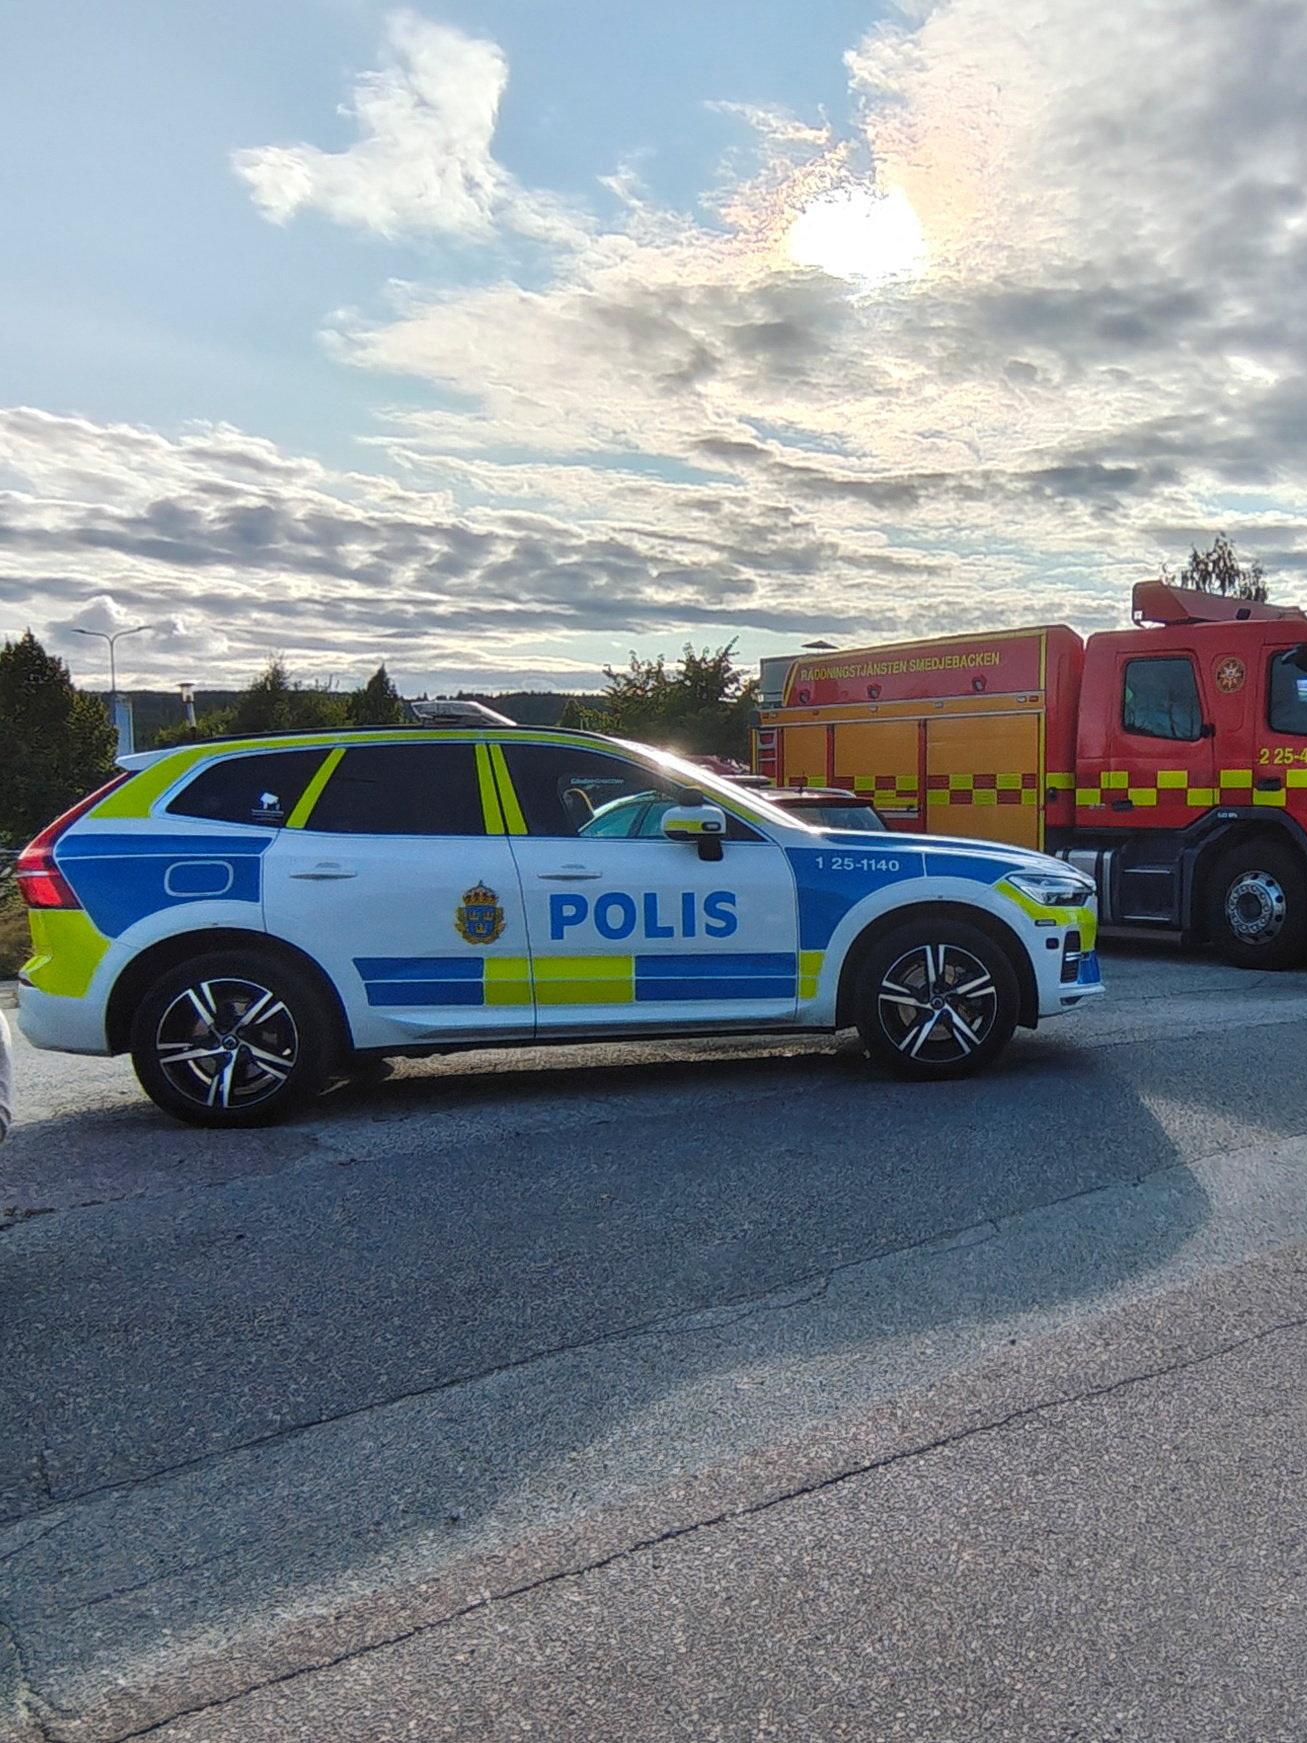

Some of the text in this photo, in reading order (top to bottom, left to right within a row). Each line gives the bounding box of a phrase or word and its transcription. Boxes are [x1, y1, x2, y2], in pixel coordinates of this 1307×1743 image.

[908, 652, 1000, 672] SMEDJEBACKEN
[1259, 748, 1270, 764] 2
[815, 856, 900, 872] 1 25-1140
[550, 890, 738, 940] POLIS
